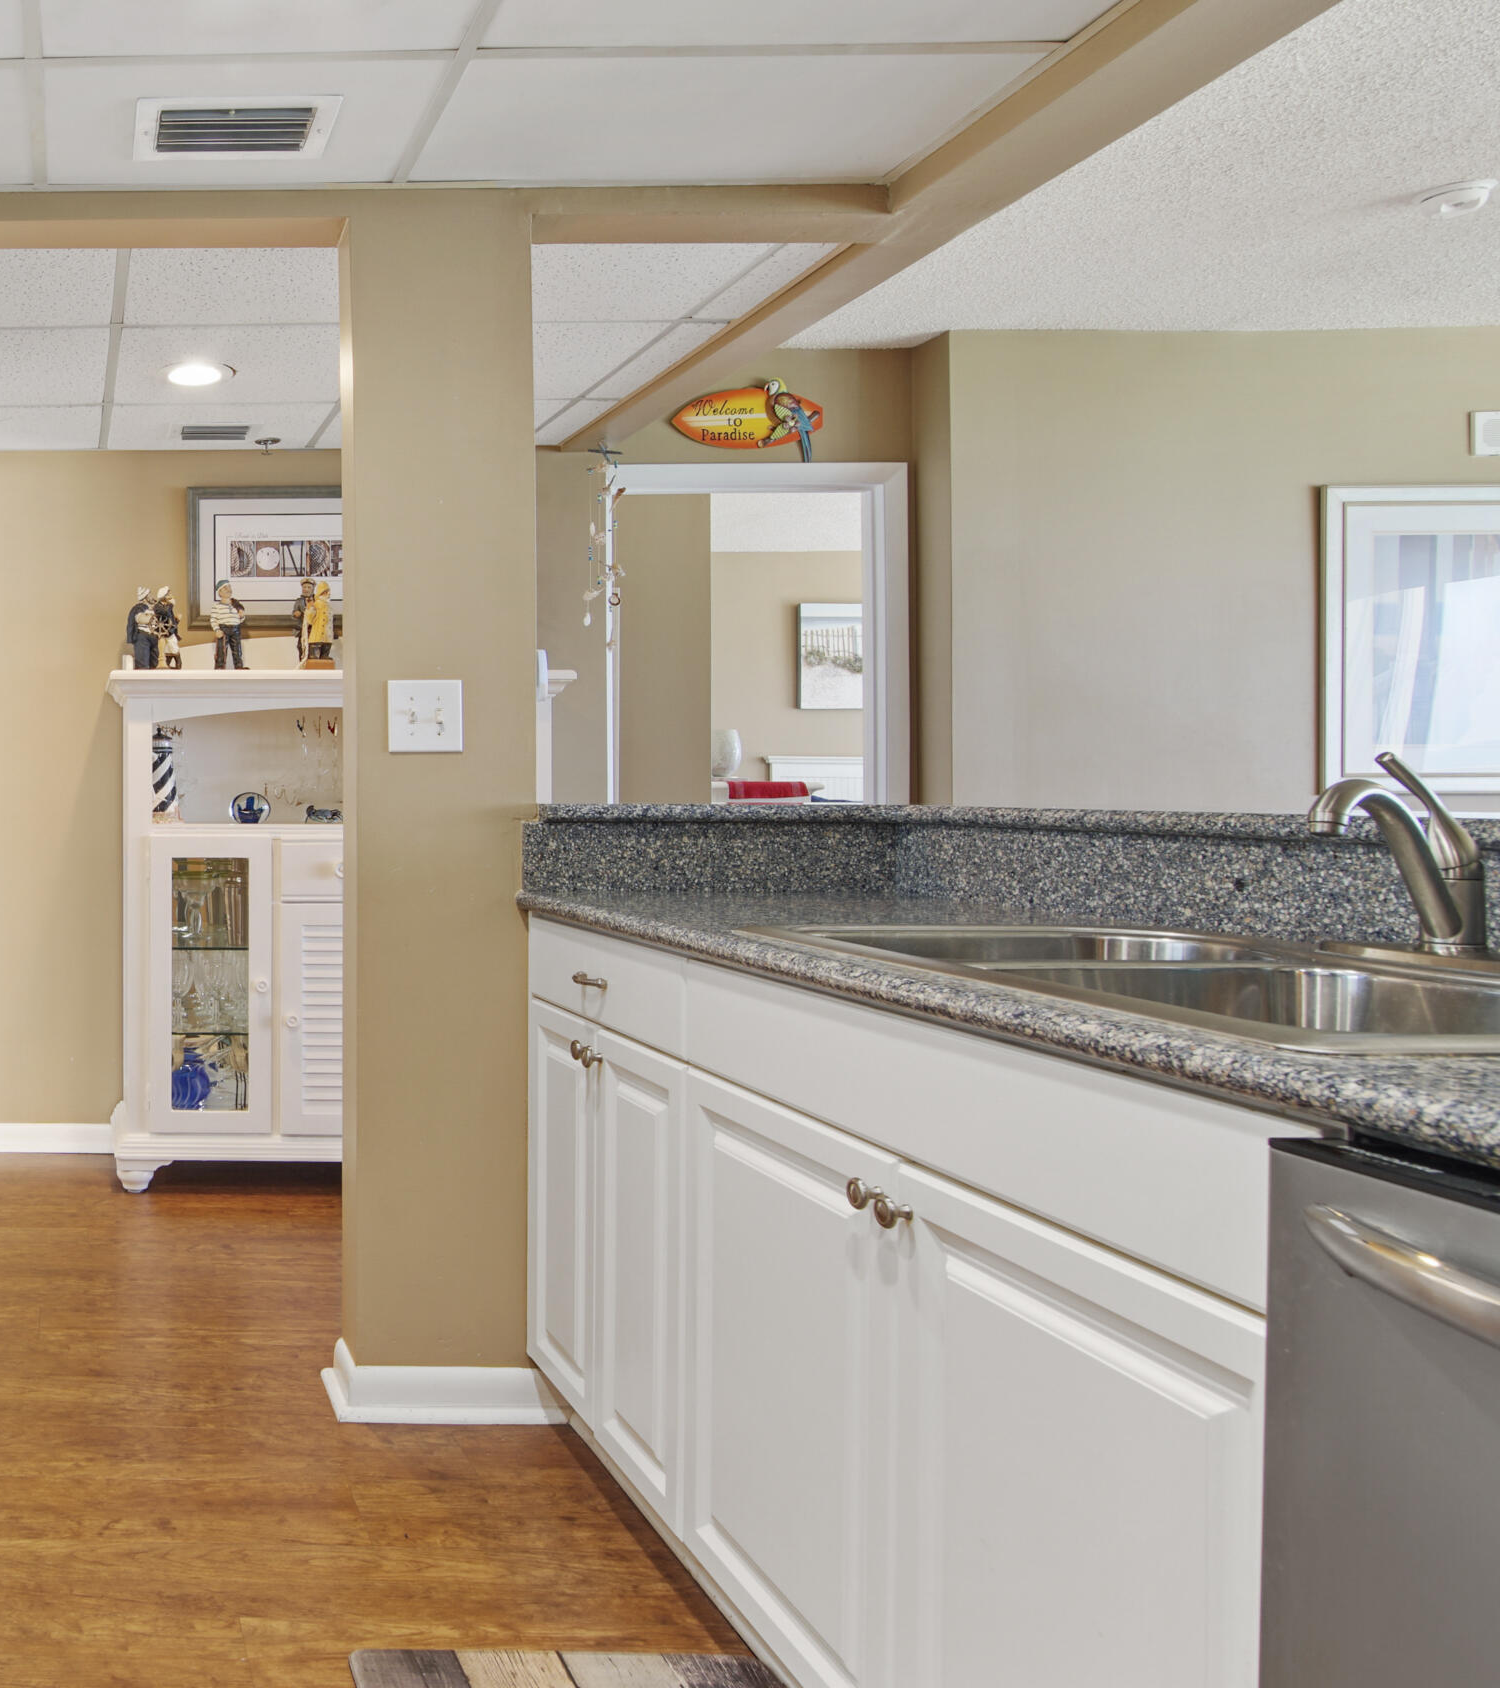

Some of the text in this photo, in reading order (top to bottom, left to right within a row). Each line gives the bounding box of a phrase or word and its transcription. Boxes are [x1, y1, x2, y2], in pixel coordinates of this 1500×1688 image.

[691, 399, 755, 417] Welcome
[727, 417, 743, 427] to
[701, 428, 755, 442] Paradise
